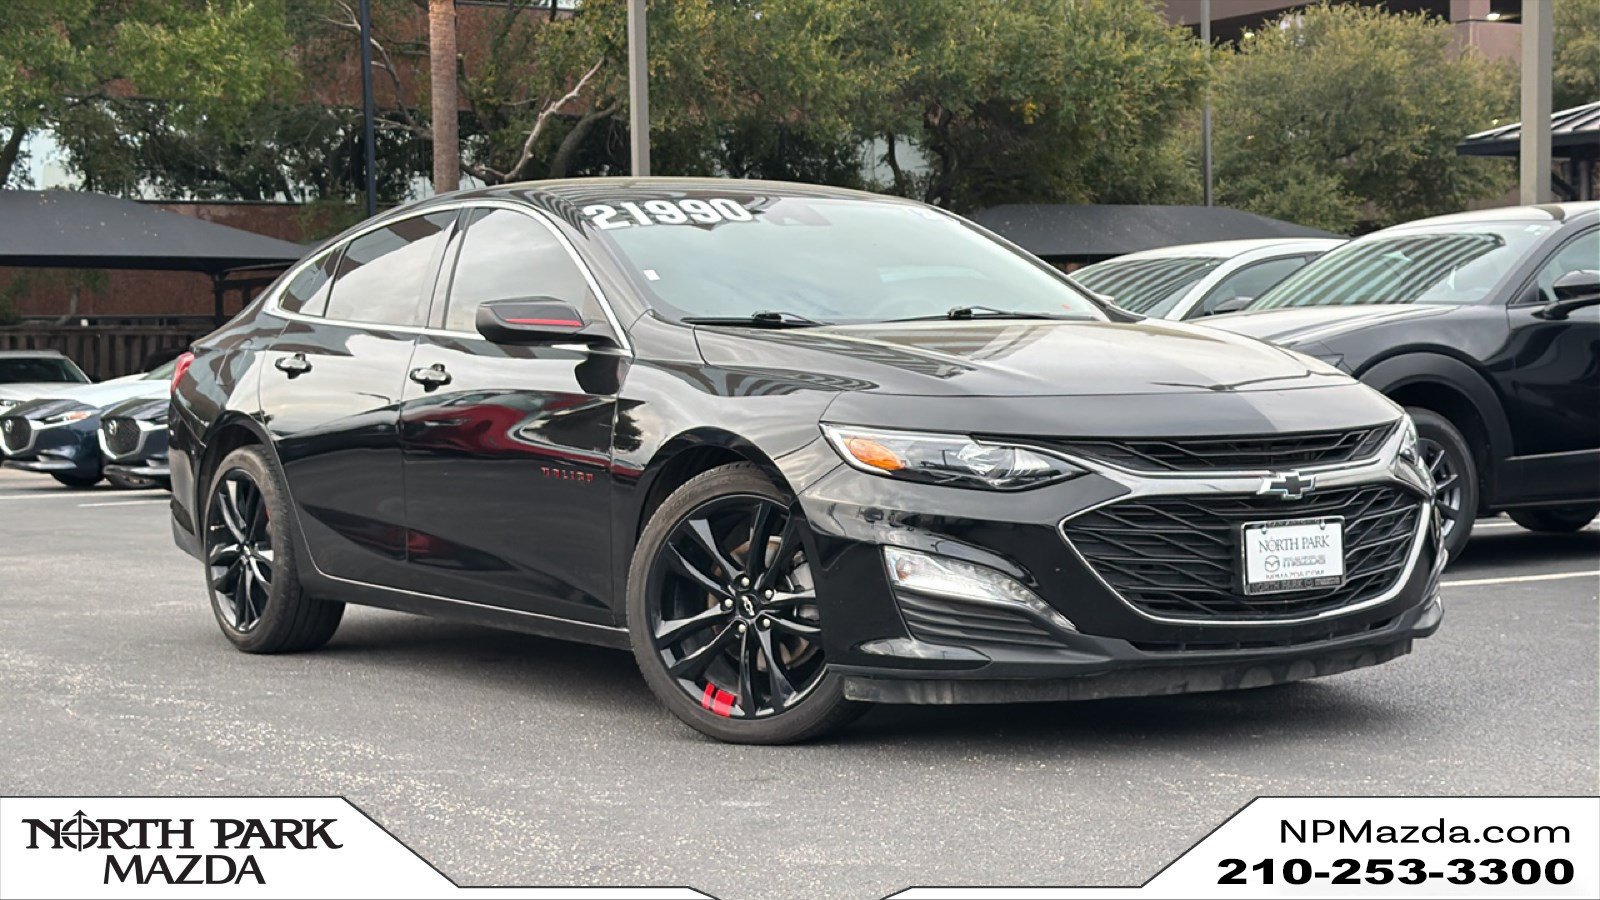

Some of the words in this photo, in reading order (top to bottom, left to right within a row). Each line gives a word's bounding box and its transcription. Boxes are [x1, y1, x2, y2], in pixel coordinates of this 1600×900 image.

[583, 198, 753, 230] 21990
[1258, 537, 1299, 553] NORTH
[1302, 534, 1330, 550] PARK
